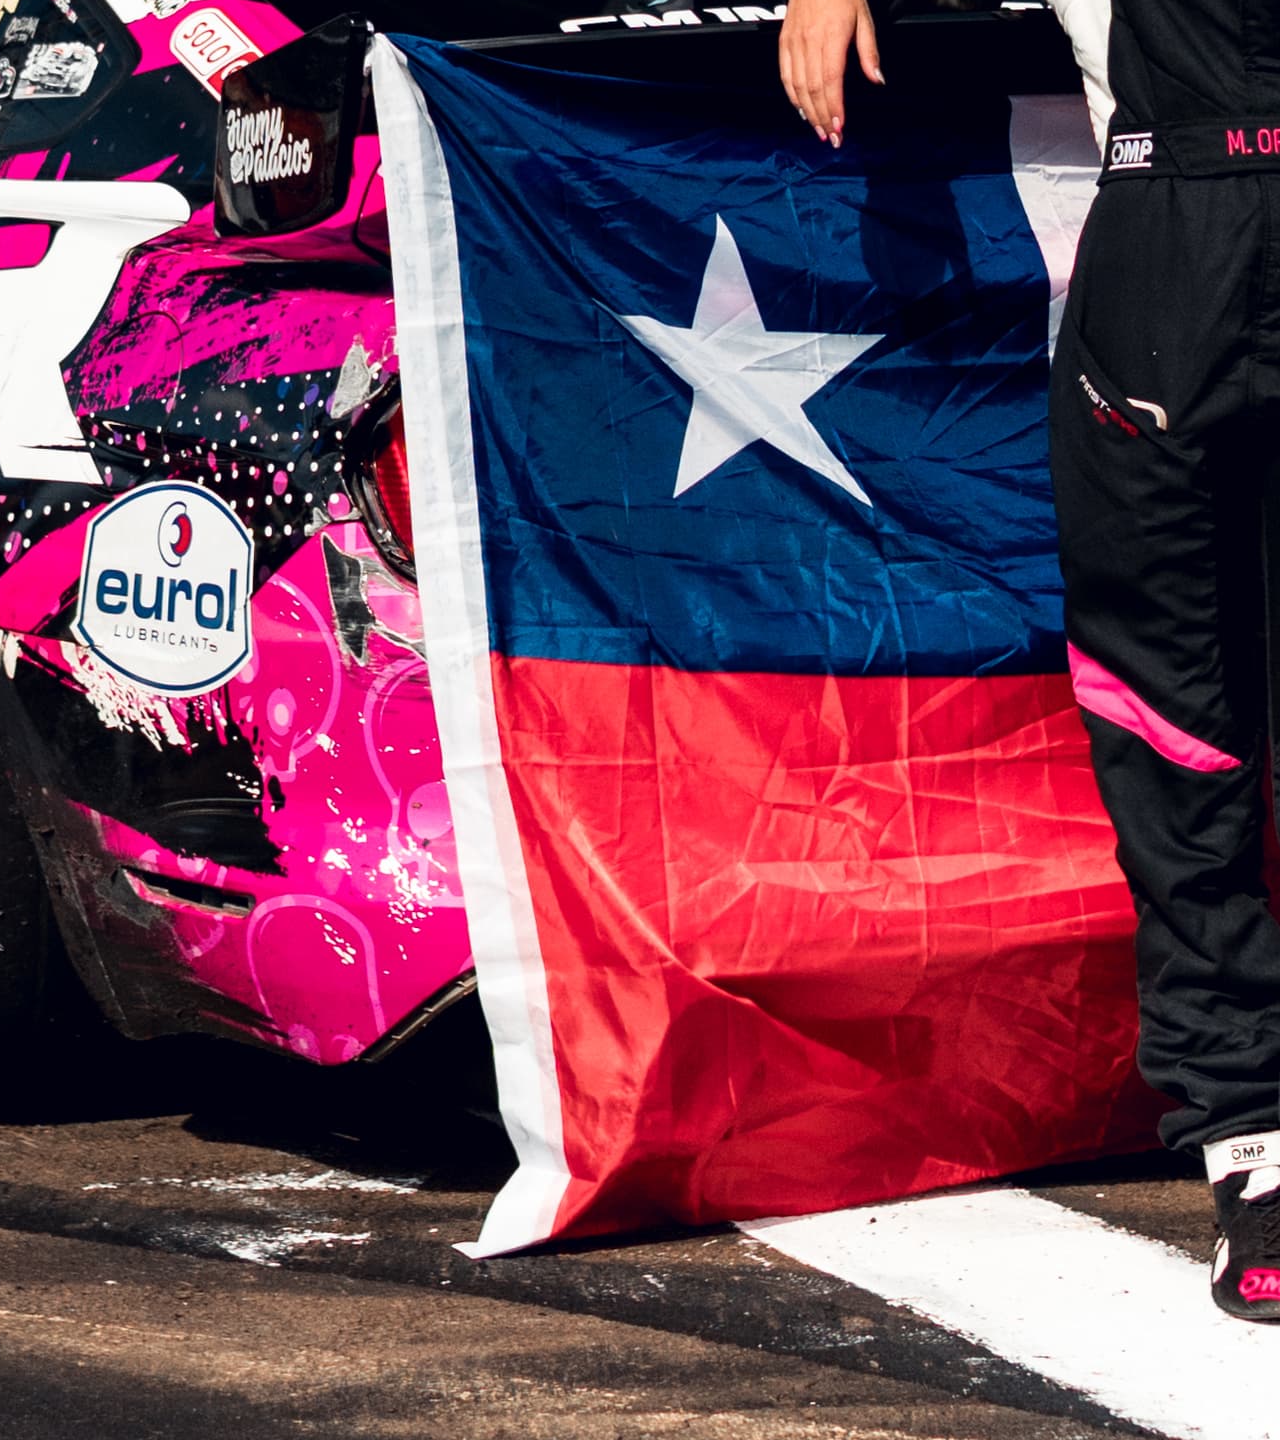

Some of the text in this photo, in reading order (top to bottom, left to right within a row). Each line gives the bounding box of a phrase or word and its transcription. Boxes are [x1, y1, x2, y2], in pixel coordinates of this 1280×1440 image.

[183, 21, 232, 63] SOLO
[226, 107, 285, 152] Jimmy
[1226, 128, 1254, 156] M.
[1111, 139, 1153, 165] OMP
[95, 568, 238, 633] eurol
[1231, 1144, 1266, 1161] OMP
